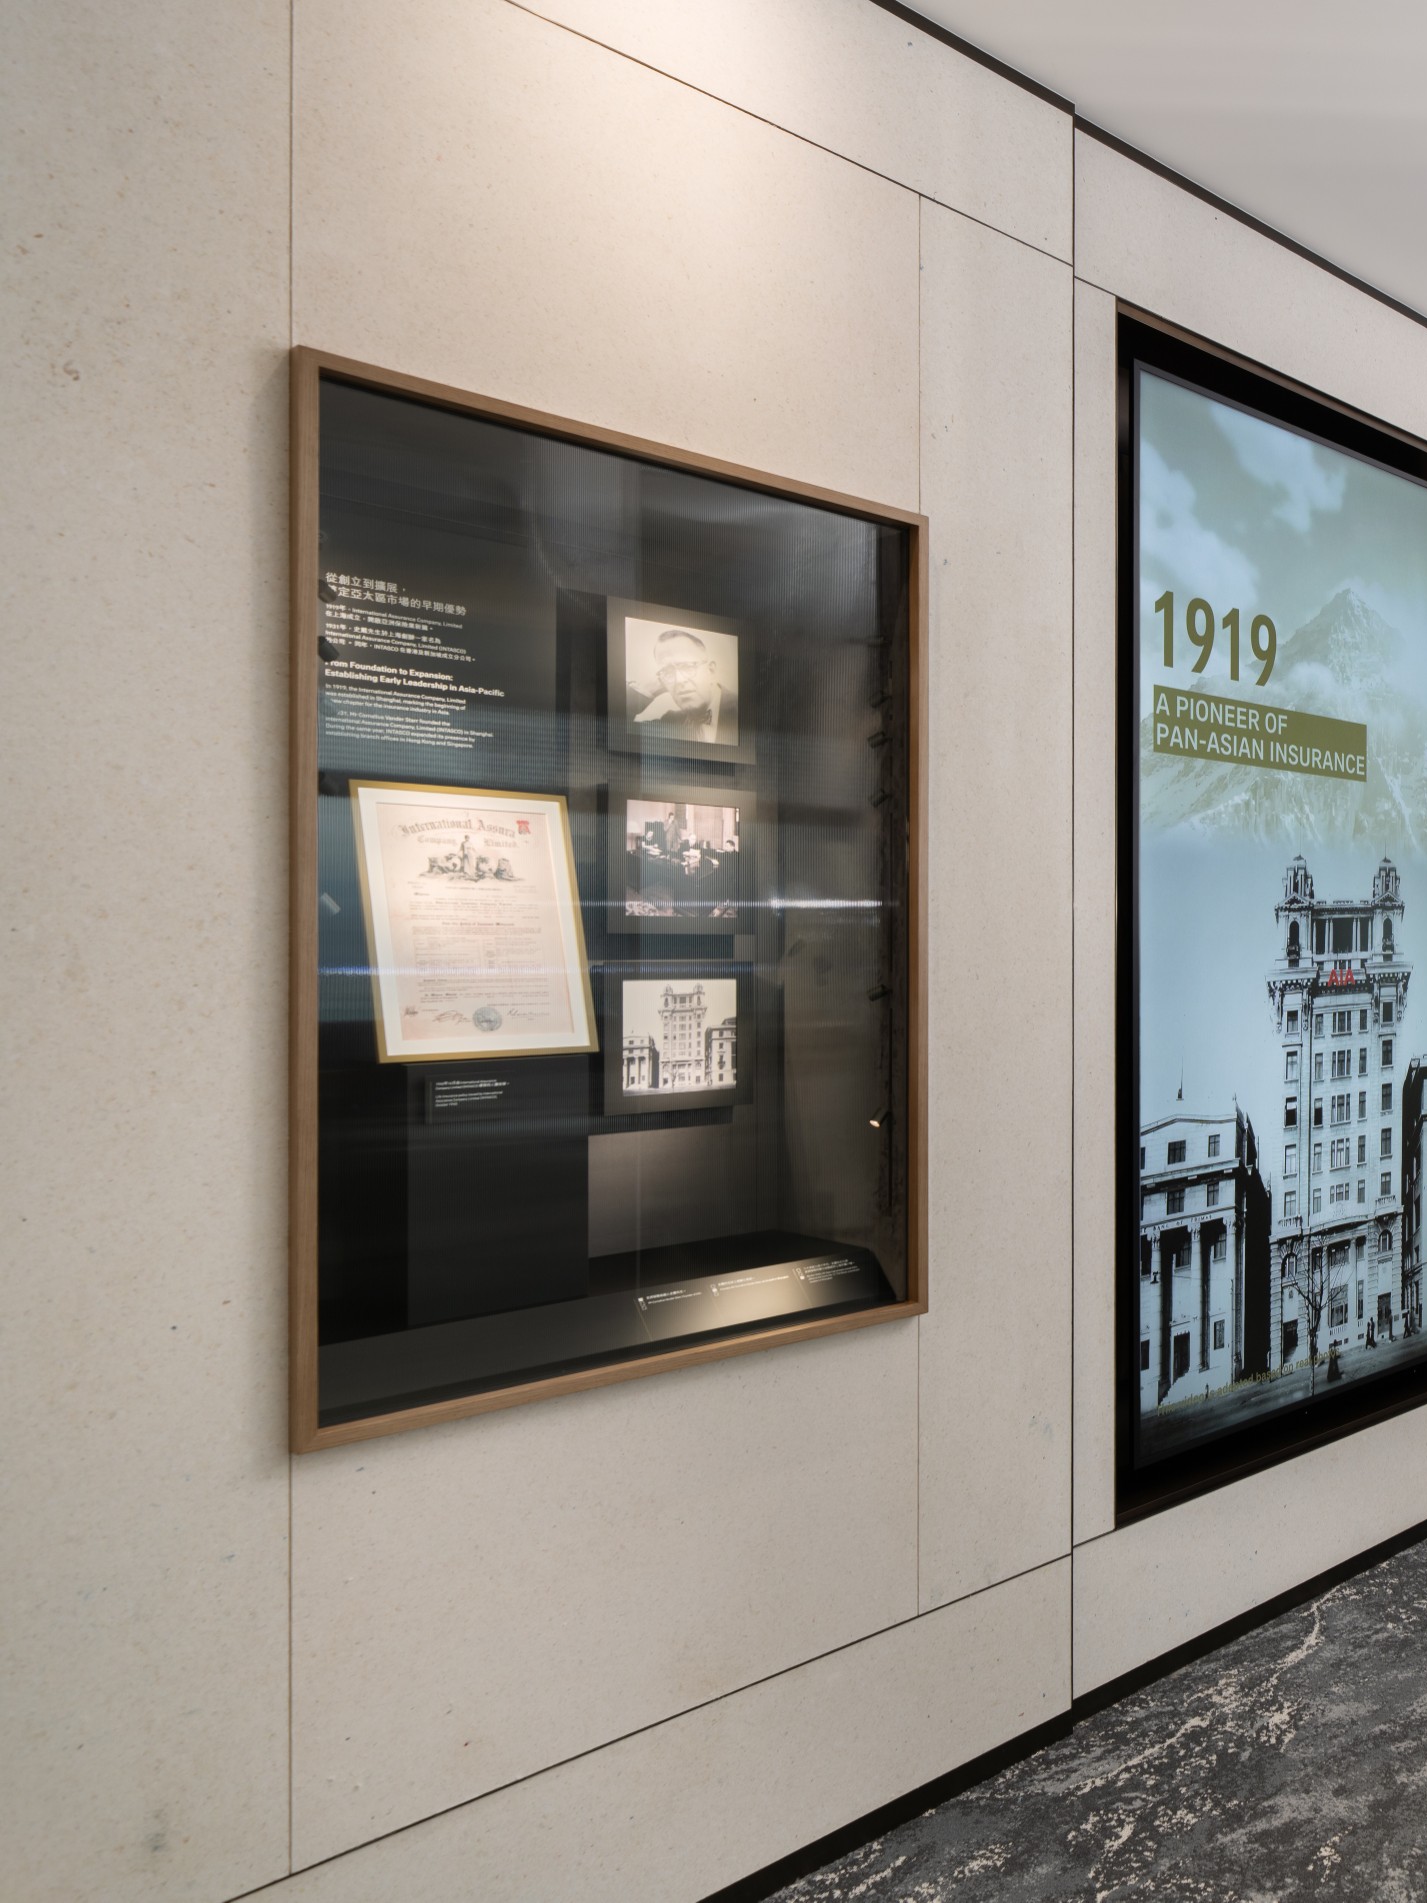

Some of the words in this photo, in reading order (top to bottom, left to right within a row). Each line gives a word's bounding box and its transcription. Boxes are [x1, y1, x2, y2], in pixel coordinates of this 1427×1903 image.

[1154, 590, 1277, 687] 1919
[324, 669, 378, 683] Establishing
[380, 675, 401, 686] Early
[403, 679, 448, 691] Leadership
[458, 685, 505, 697] Asia-Pacific
[349, 661, 397, 674] Foundation
[409, 669, 453, 681] Expansion:
[1155, 692, 1170, 716] A
[1176, 696, 1260, 732] PIONEER
[1265, 712, 1288, 736] OF
[1156, 723, 1264, 761] PAN-ASIAN
[1270, 741, 1365, 776] INSURANCE
[399, 818, 473, 837] International
[477, 818, 520, 839] Assura
[1327, 967, 1355, 987] AIA
